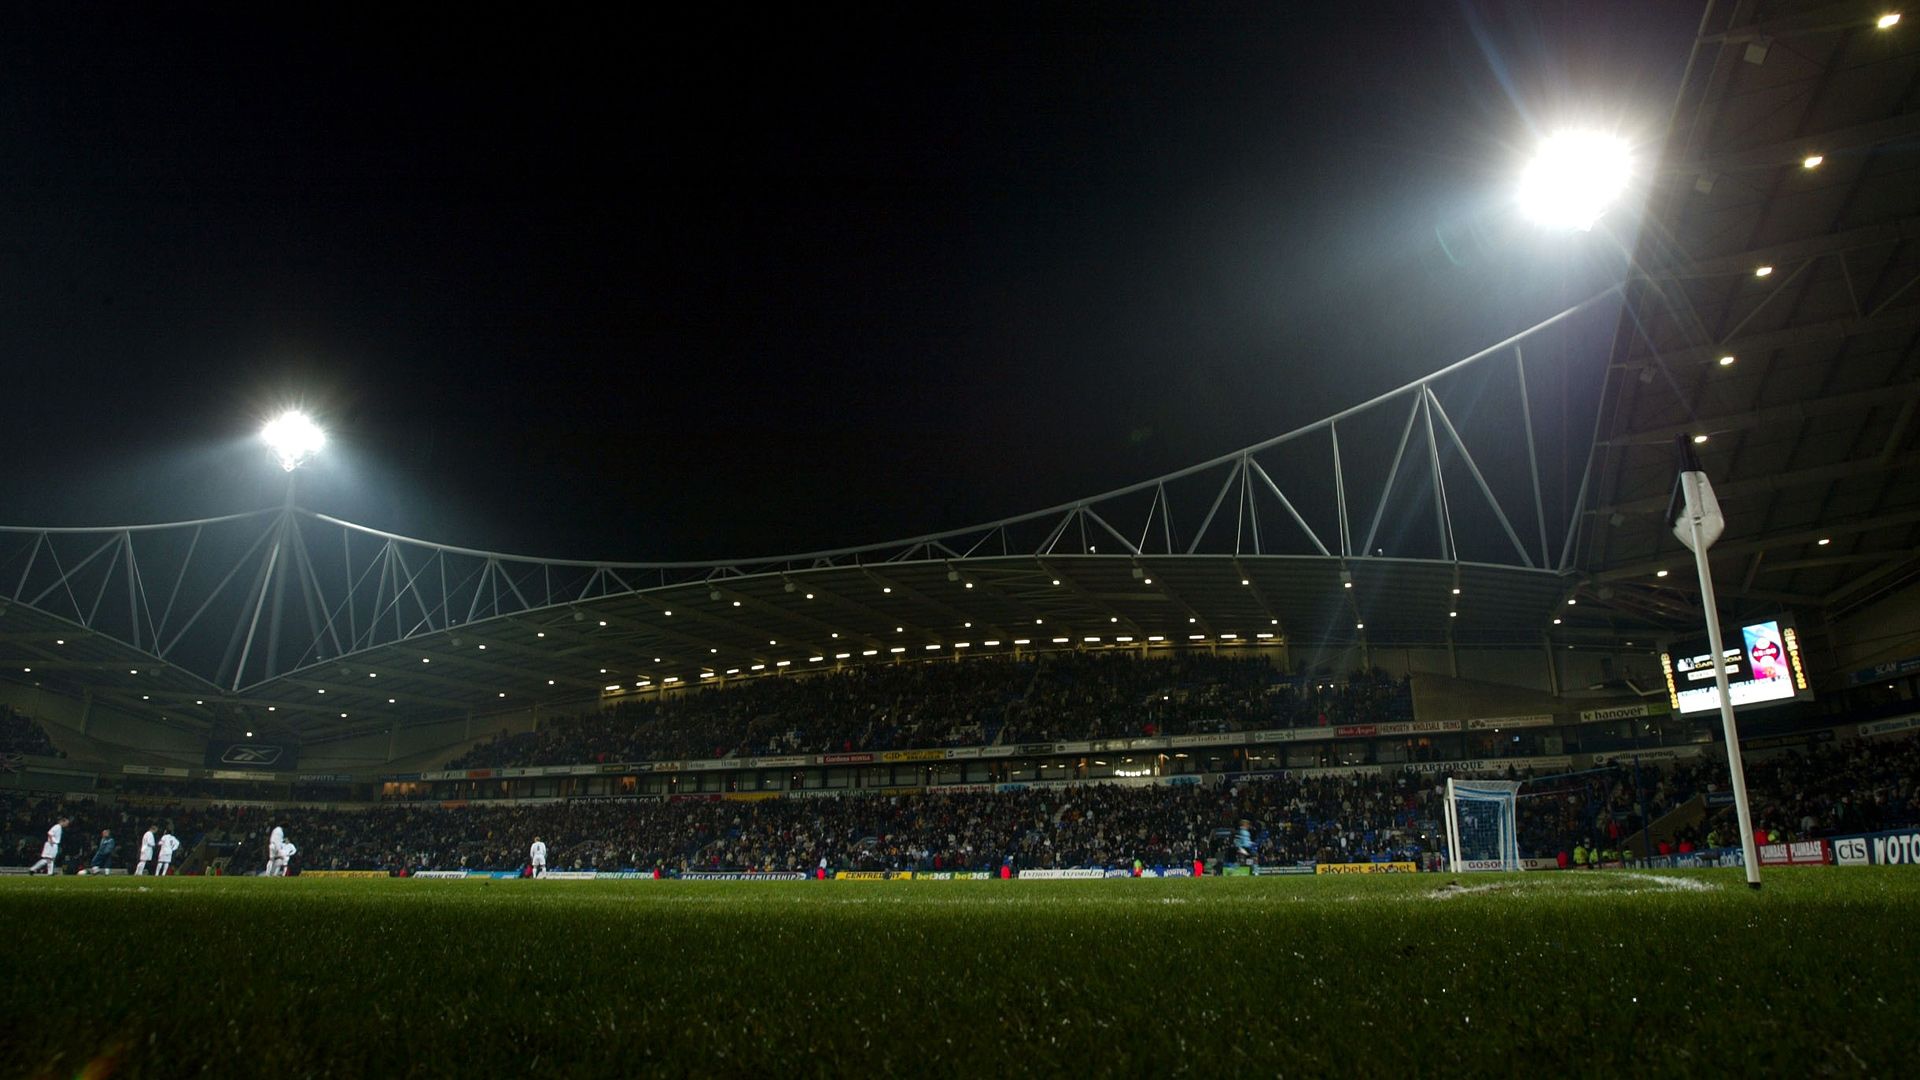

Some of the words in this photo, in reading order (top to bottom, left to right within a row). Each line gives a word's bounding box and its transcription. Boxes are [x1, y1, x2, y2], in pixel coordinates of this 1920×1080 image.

[1595, 706, 1644, 720] hanover
[1320, 864, 1362, 874] skybet
[916, 872, 950, 880] bet365
[954, 872, 989, 880] bet365
